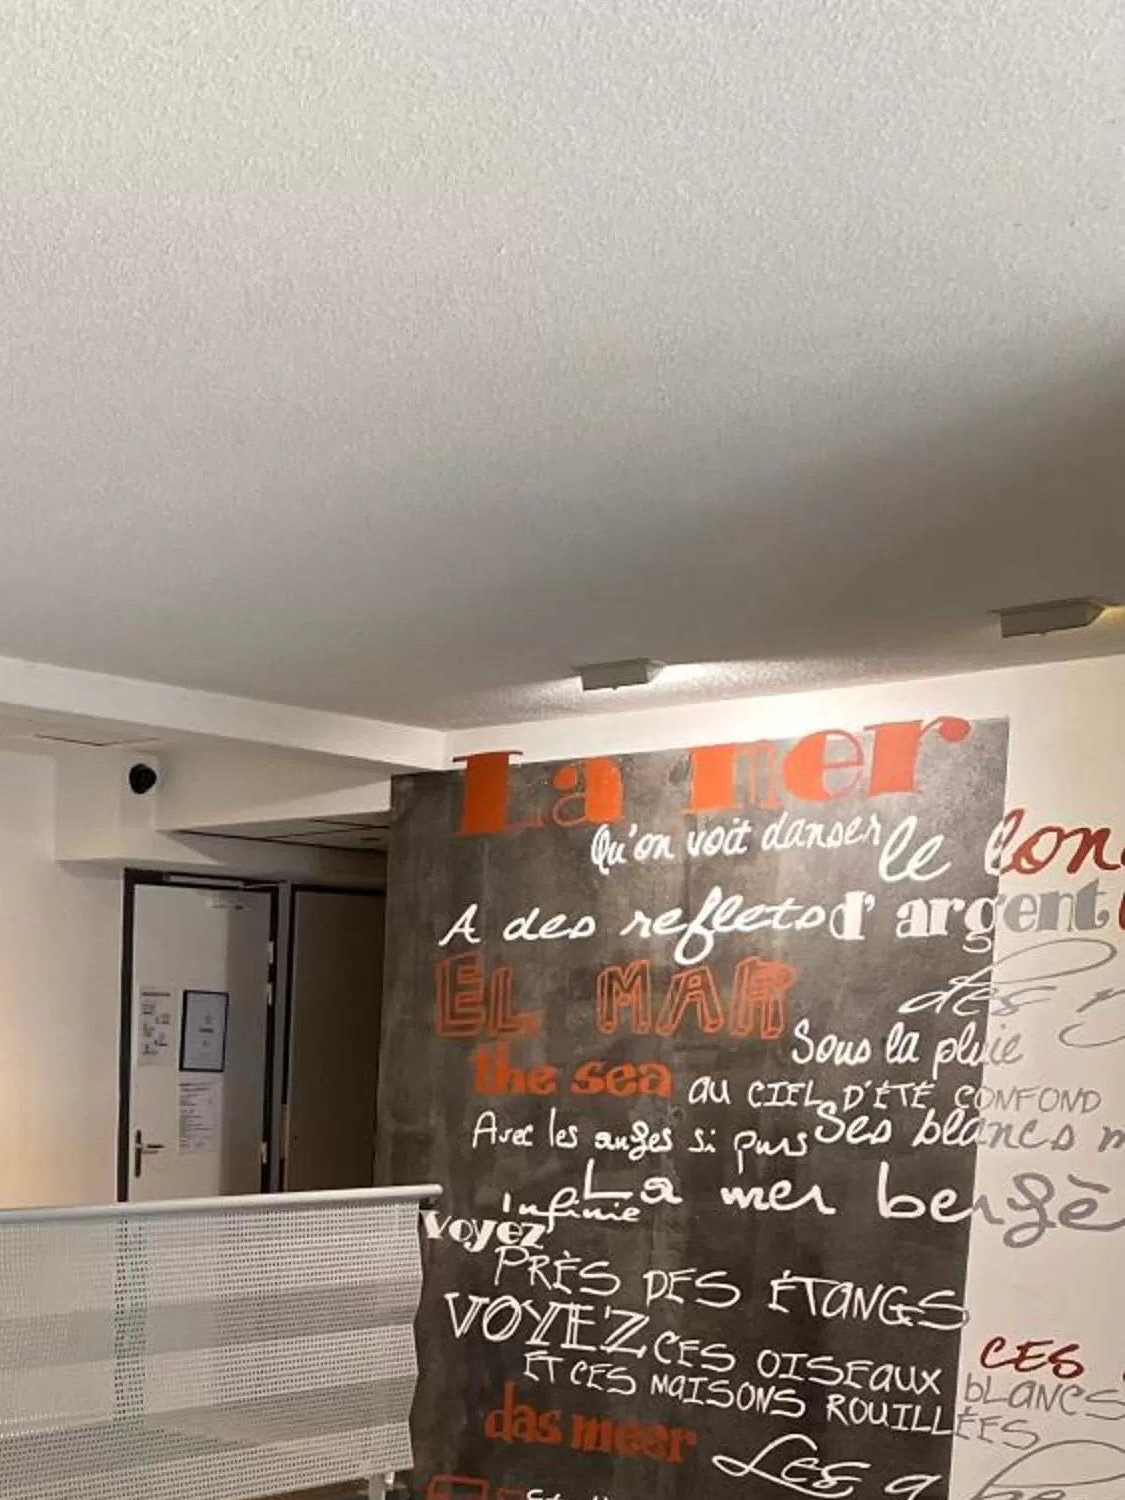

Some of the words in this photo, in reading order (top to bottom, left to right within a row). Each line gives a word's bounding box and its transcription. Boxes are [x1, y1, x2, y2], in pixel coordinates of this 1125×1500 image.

[453, 750, 624, 837] La
[681, 716, 971, 815] mer
[590, 824, 674, 875] Qu'on
[687, 817, 751, 857] voit
[764, 811, 881, 849] danser
[878, 816, 952, 882] le
[985, 808, 1125, 876] lon
[438, 903, 481, 946] A
[502, 907, 596, 941] des
[619, 885, 826, 966] reflets
[435, 951, 545, 1039] EL
[596, 955, 796, 1042] MAR
[469, 1042, 557, 1097] the
[571, 1058, 672, 1098] sea
[792, 1018, 871, 1065] Sous
[886, 1022, 920, 1064] la
[933, 1022, 1023, 1080] pluie
[748, 1081, 824, 1108] CIEL
[954, 1087, 1102, 1114] CONFOND
[814, 1101, 892, 1145] Ses
[913, 1108, 1074, 1152] blancs
[549, 1107, 579, 1149] les
[594, 1120, 673, 1161] anges
[583, 1158, 683, 1204] La
[721, 1179, 836, 1216] mer
[494, 1245, 621, 1297] PRÈS
[643, 1267, 742, 1308] DES
[444, 1292, 650, 1360] VOYEZ
[654, 1330, 736, 1373] CES
[756, 1349, 943, 1396] OISEAUX
[523, 1350, 564, 1384] ET
[570, 1360, 637, 1396] CES
[979, 1336, 1084, 1380] CES
[484, 1380, 563, 1444] das
[571, 1412, 699, 1464] meer
[711, 1433, 871, 1499] Les
